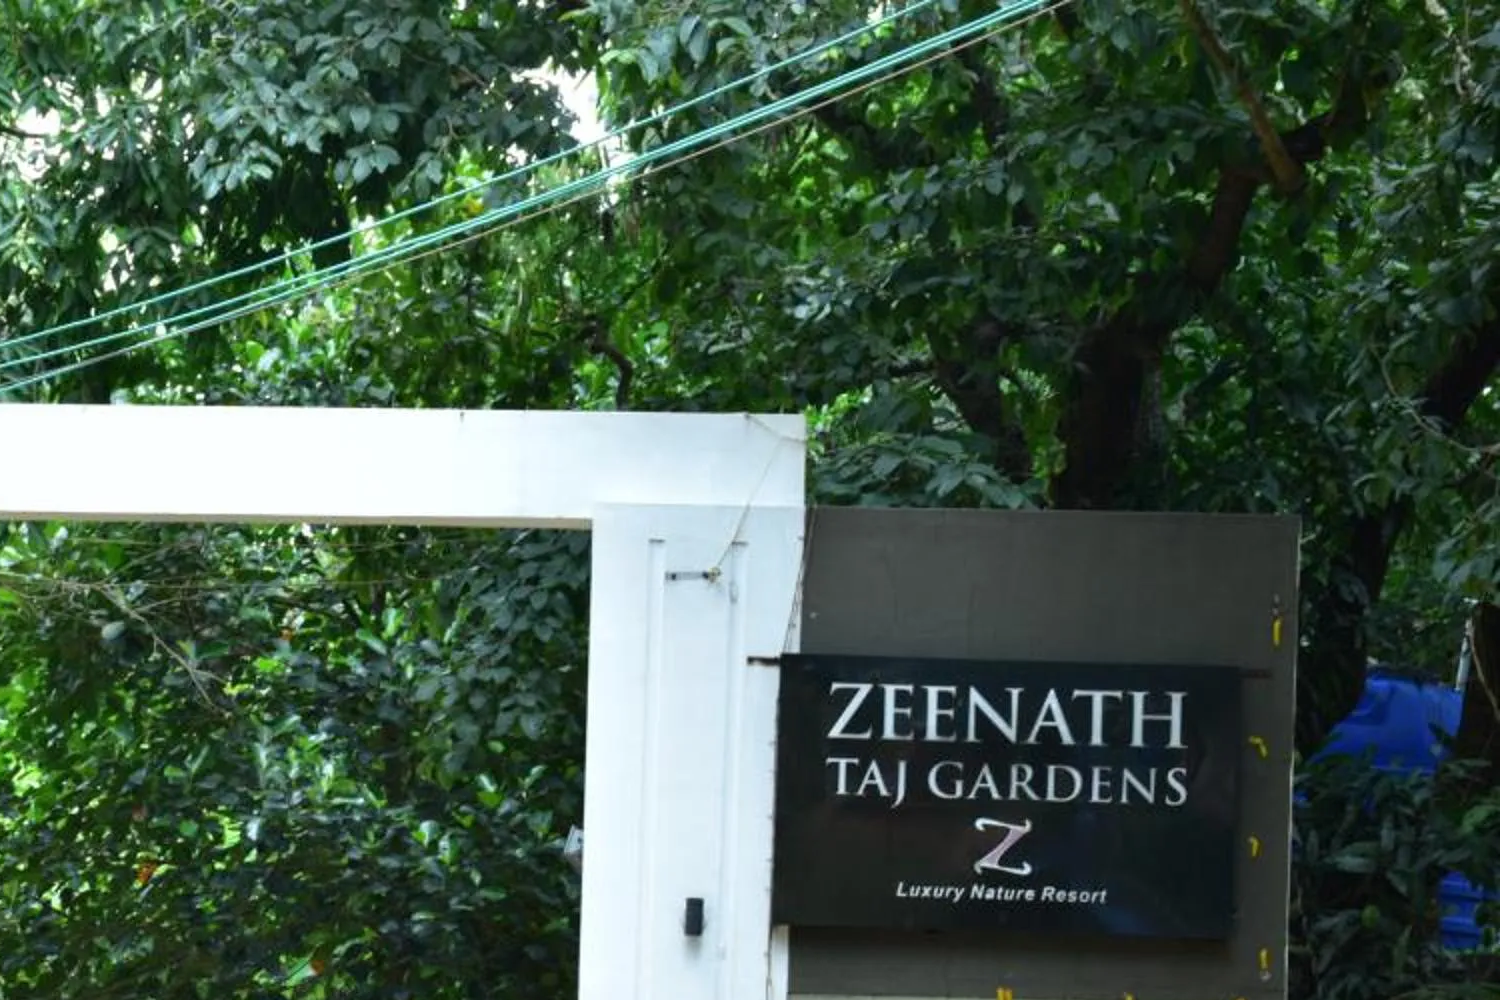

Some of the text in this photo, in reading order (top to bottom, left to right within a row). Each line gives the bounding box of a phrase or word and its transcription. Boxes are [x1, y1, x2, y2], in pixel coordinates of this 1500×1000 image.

[826, 682, 1188, 749] ZEENATH
[825, 757, 1188, 808] TAJ GARDENS
[896, 881, 1108, 904] Luxury Nature Resort
